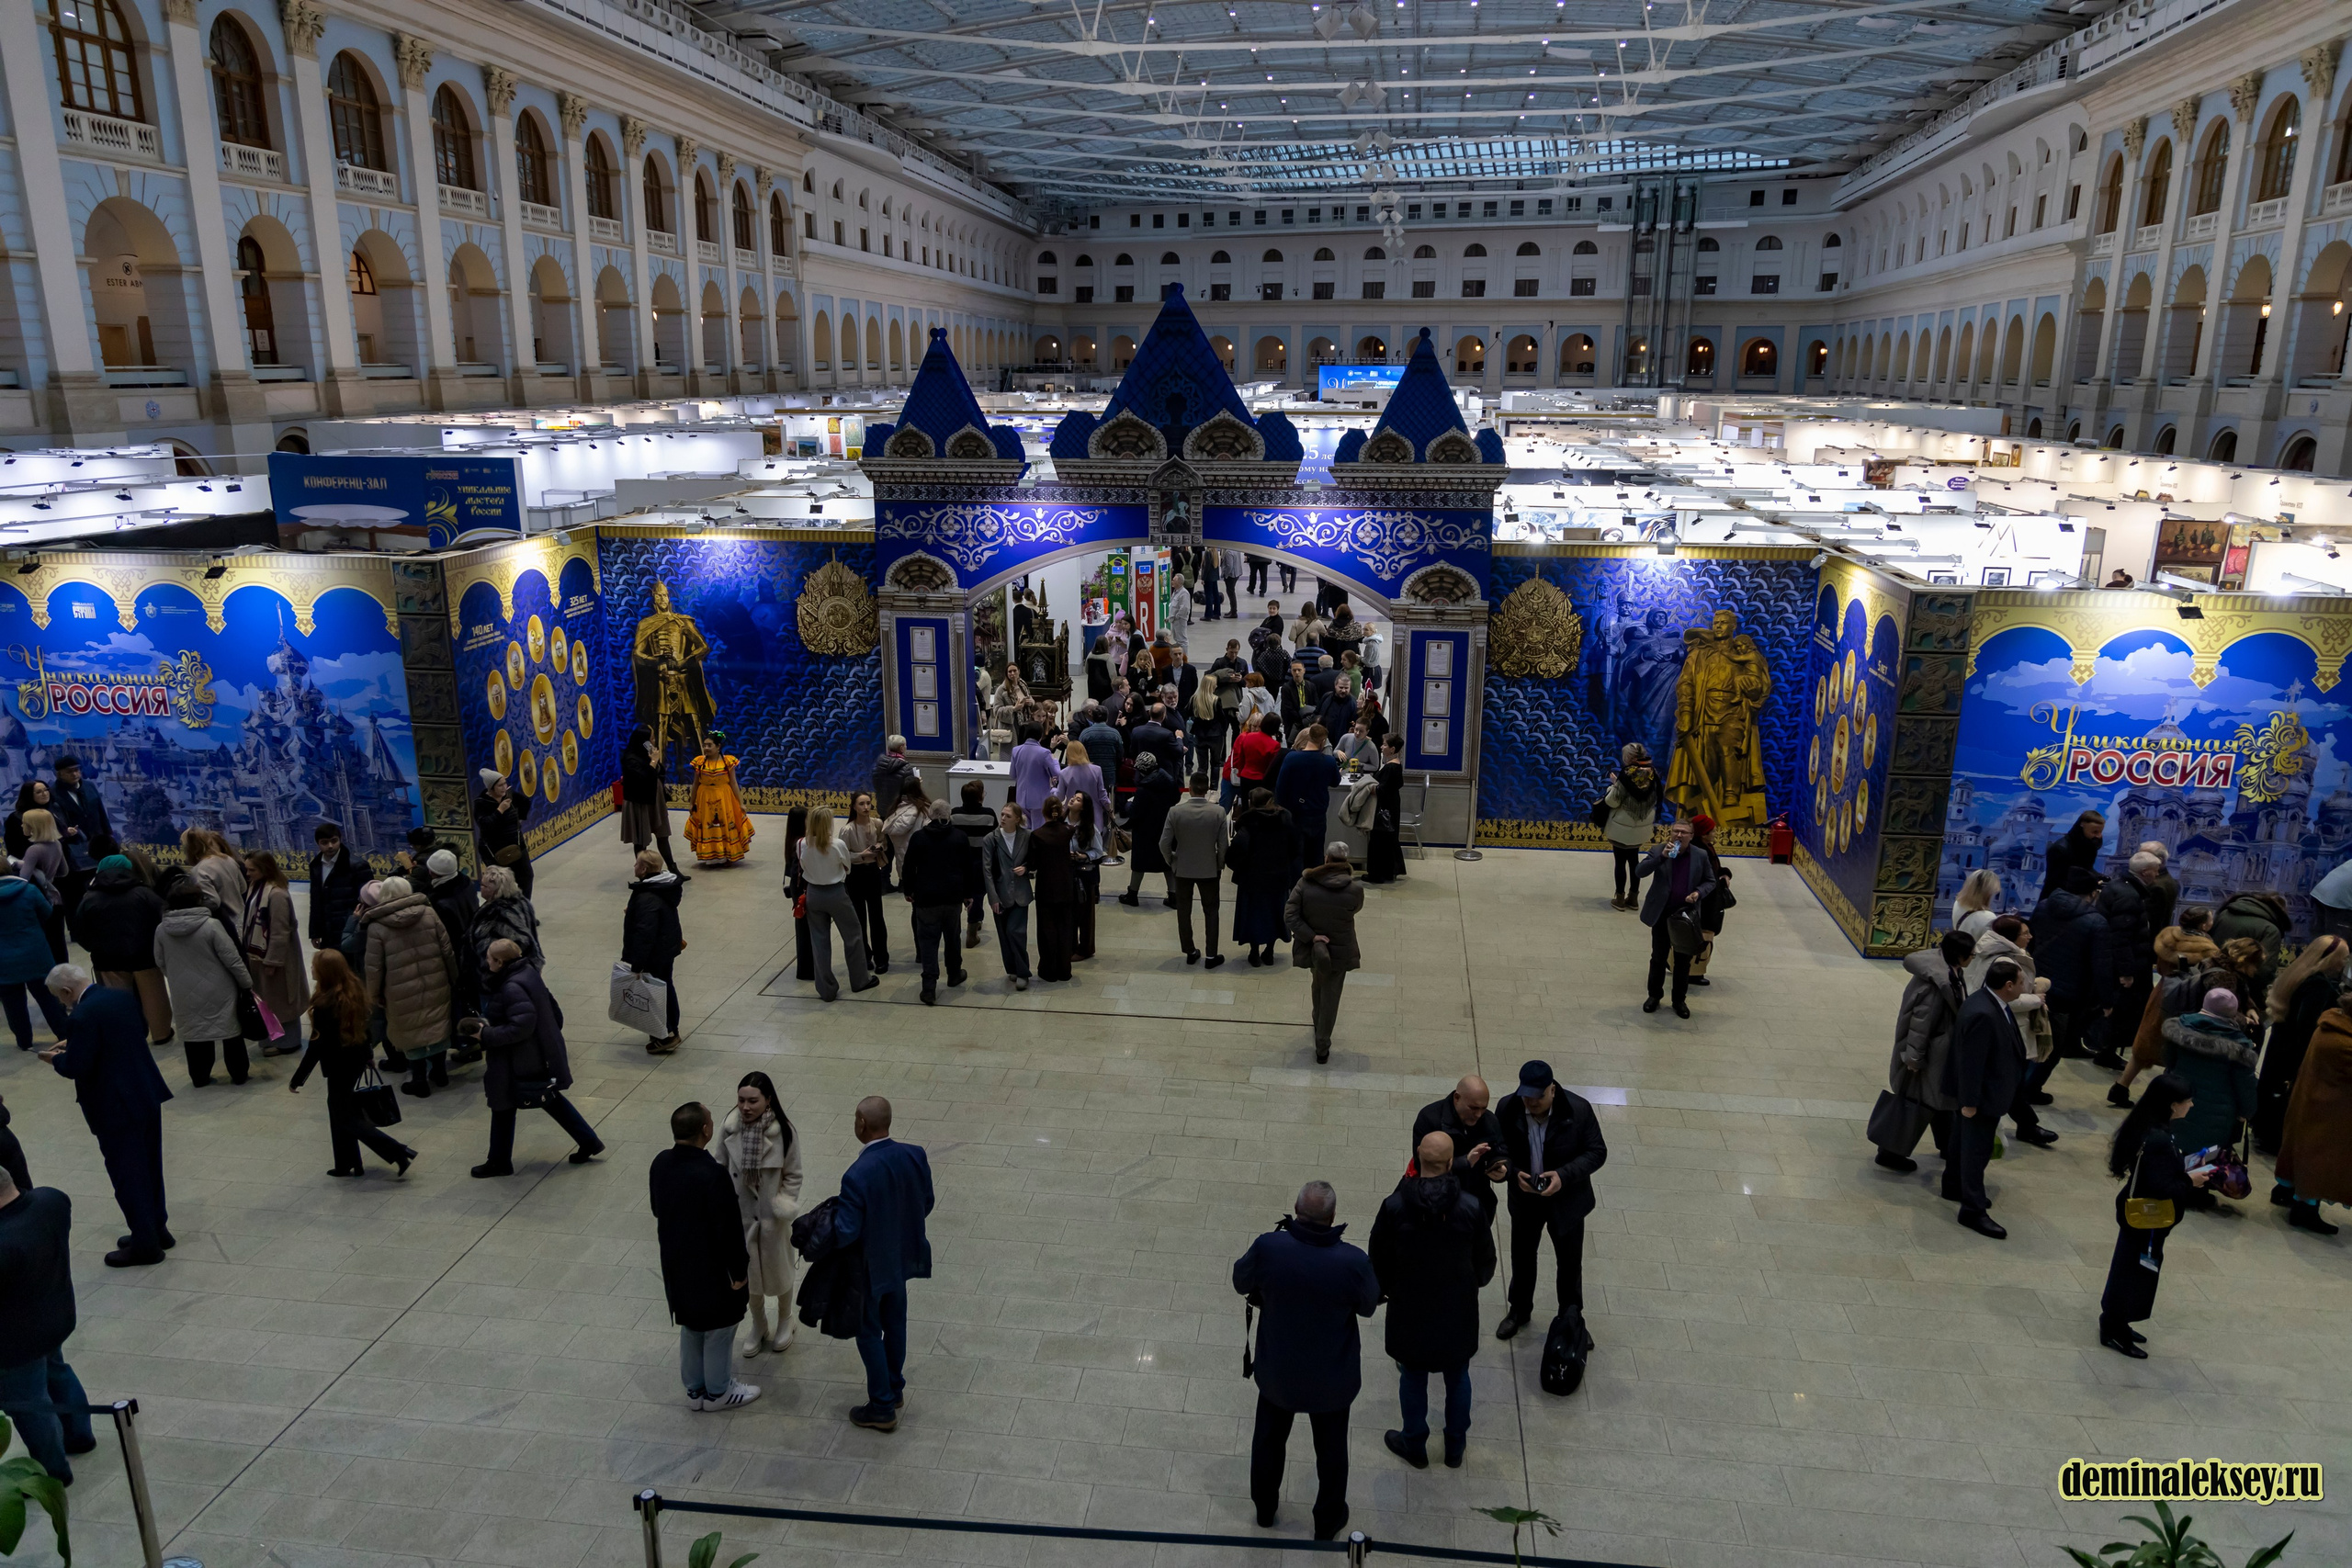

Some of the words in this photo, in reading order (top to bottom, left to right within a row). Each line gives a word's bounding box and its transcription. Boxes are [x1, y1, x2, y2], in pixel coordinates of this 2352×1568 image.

[107, 278, 128, 287] ESTER
[303, 476, 388, 491] КОНФЕРЕНЦ-ЗАЛ
[471, 625, 483, 637] 140
[483, 623, 494, 634] ЛЕТ
[8, 643, 171, 719] Уникальная
[49, 683, 171, 716] РОССИЯ
[2030, 701, 2242, 790] Уникальная
[2066, 749, 2236, 789] РОССИЯ
